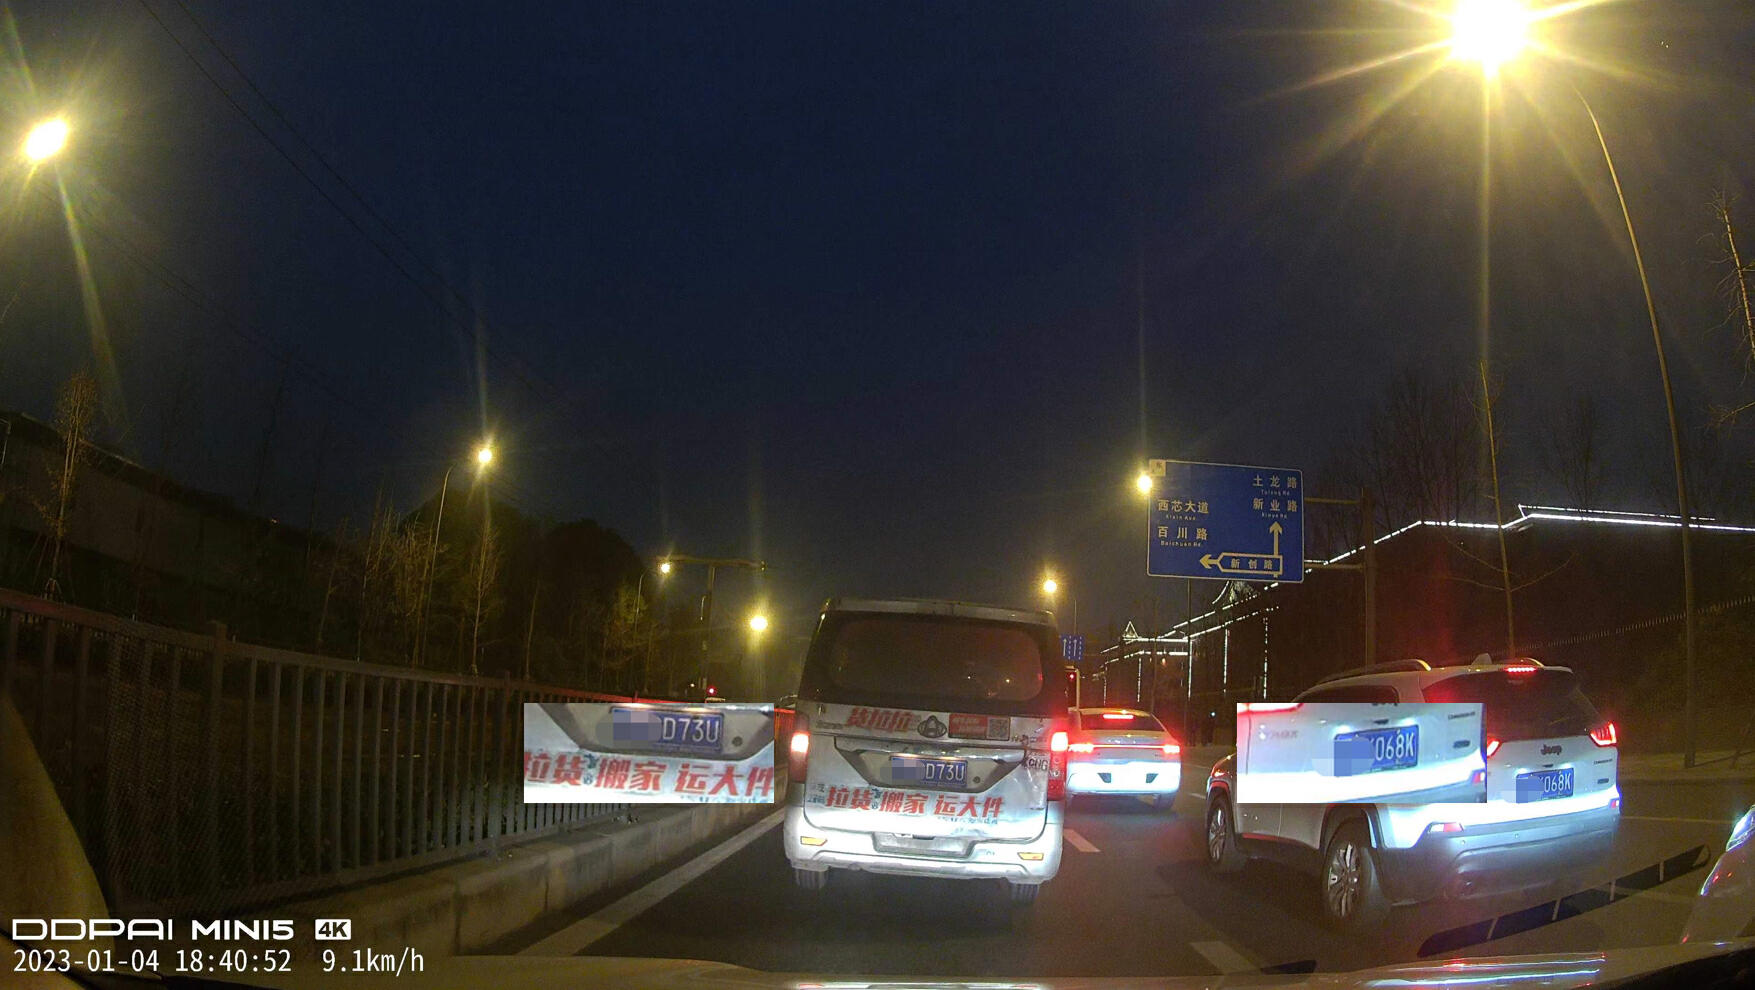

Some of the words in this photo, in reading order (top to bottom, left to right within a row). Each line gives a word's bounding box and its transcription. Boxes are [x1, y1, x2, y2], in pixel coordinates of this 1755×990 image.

[1252, 474, 1297, 489] 土龙路
[1157, 499, 1209, 514] 西芯大道
[1253, 497, 1298, 512] 新业路
[1157, 526, 1208, 540] 百川路
[1231, 558, 1273, 570] 新创路
[1368, 732, 1416, 762] 068K
[1540, 744, 1563, 756] Jeep
[594, 755, 668, 792] 搬家
[674, 762, 774, 797] 运大件
[1540, 772, 1572, 793] 068K
[825, 786, 872, 811] 拉货
[879, 790, 929, 815] 搬家
[933, 794, 1005, 819] 运大件
